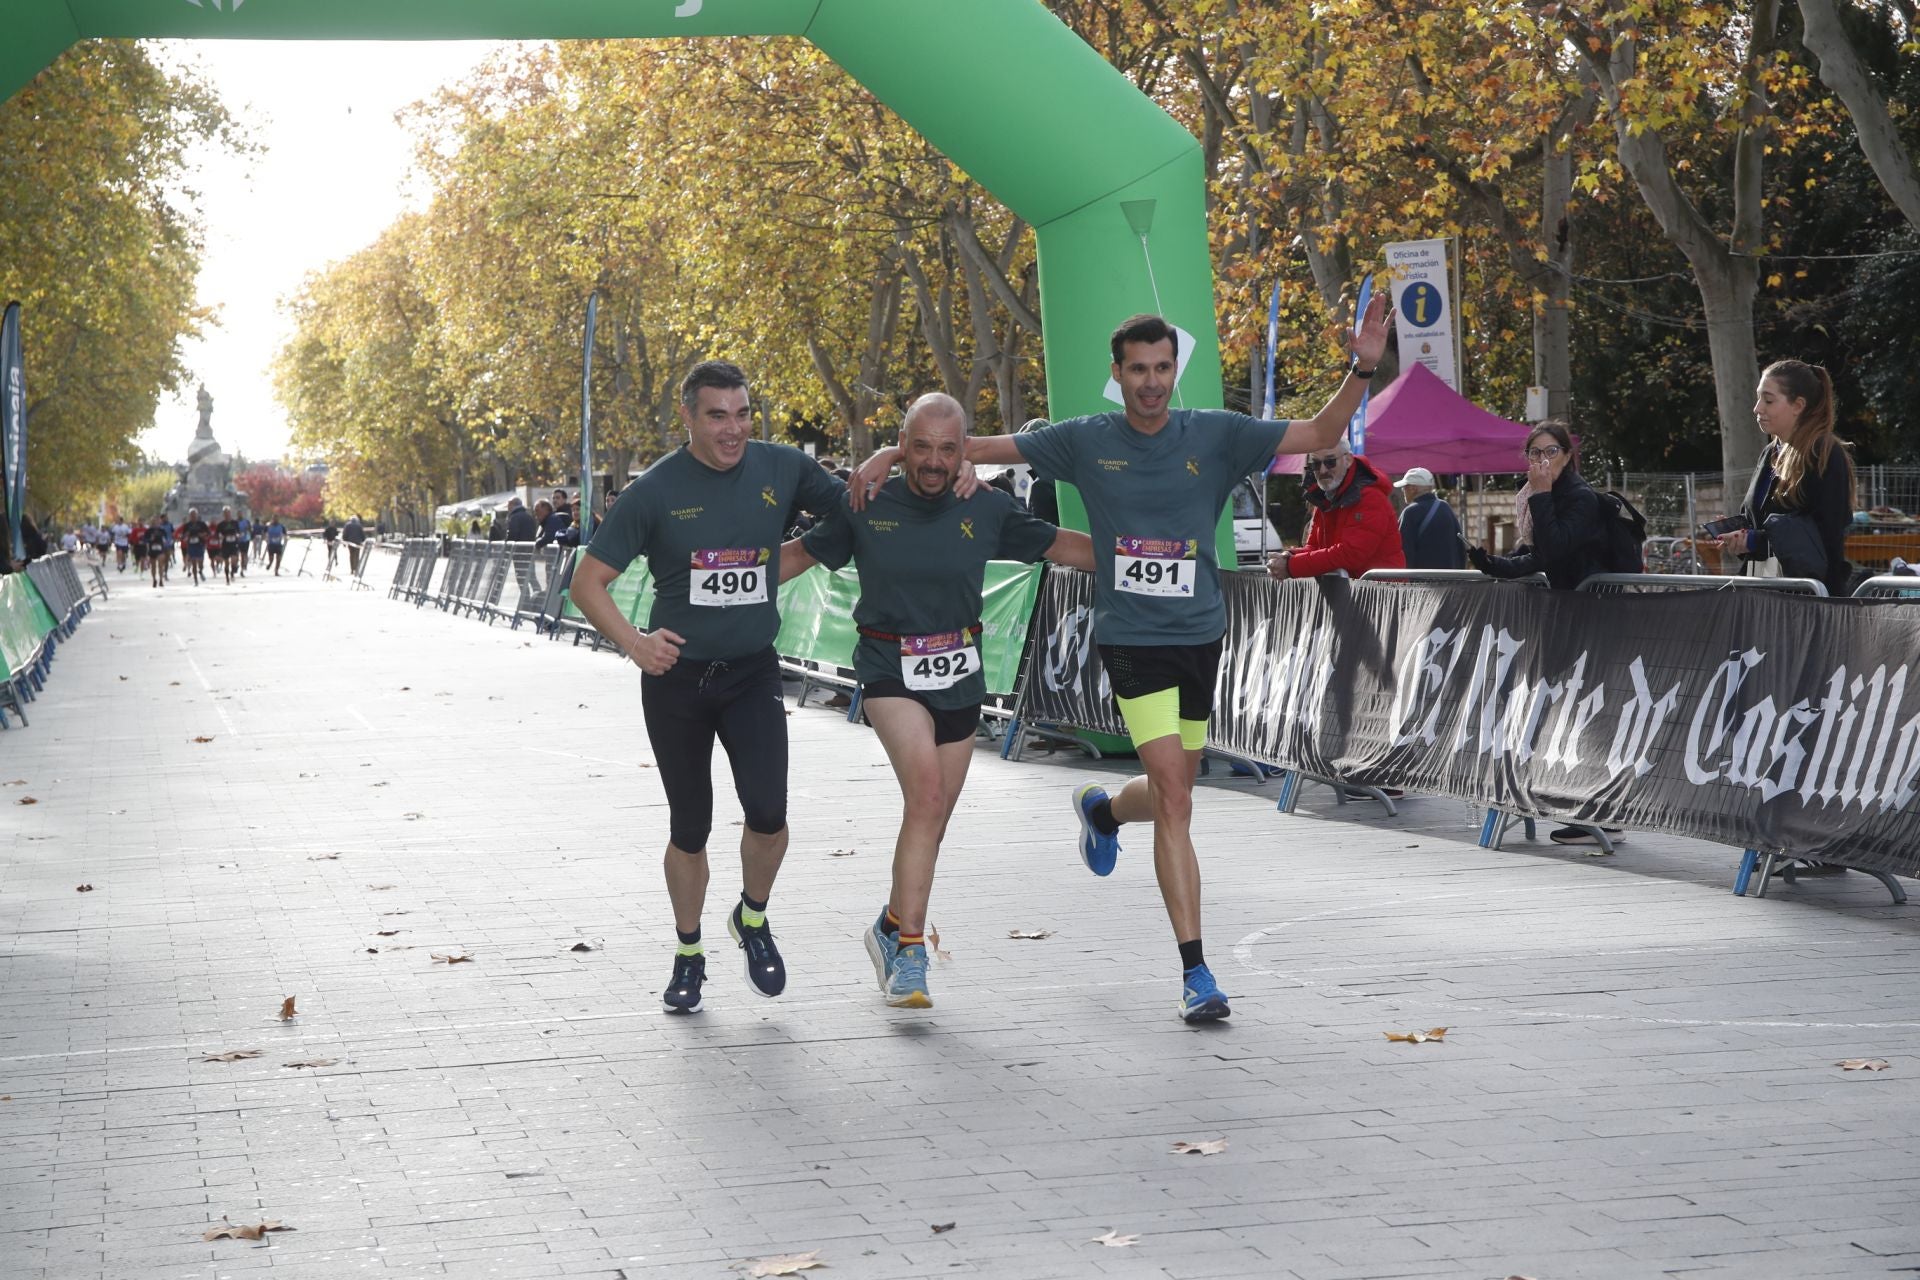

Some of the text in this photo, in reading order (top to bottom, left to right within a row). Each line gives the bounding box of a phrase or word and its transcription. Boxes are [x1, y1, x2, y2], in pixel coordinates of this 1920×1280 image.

[1393, 249, 1429, 259] Oficina de
[1097, 458, 1129, 466] GUARDIA
[671, 505, 704, 516] GUARDIA
[679, 512, 698, 521] CIVIL
[868, 519, 900, 527] GUARDIA
[1142, 539, 1165, 547] CARRERA
[1142, 545, 1172, 553] EMPRESAS
[719, 554, 747, 563] EMPRESAS
[1125, 560, 1179, 585] 491
[701, 570, 758, 595] 490
[913, 652, 969, 679] 492
[1389, 626, 1467, 748] El
[1454, 623, 1605, 773] Norte
[1605, 655, 1682, 781] de
